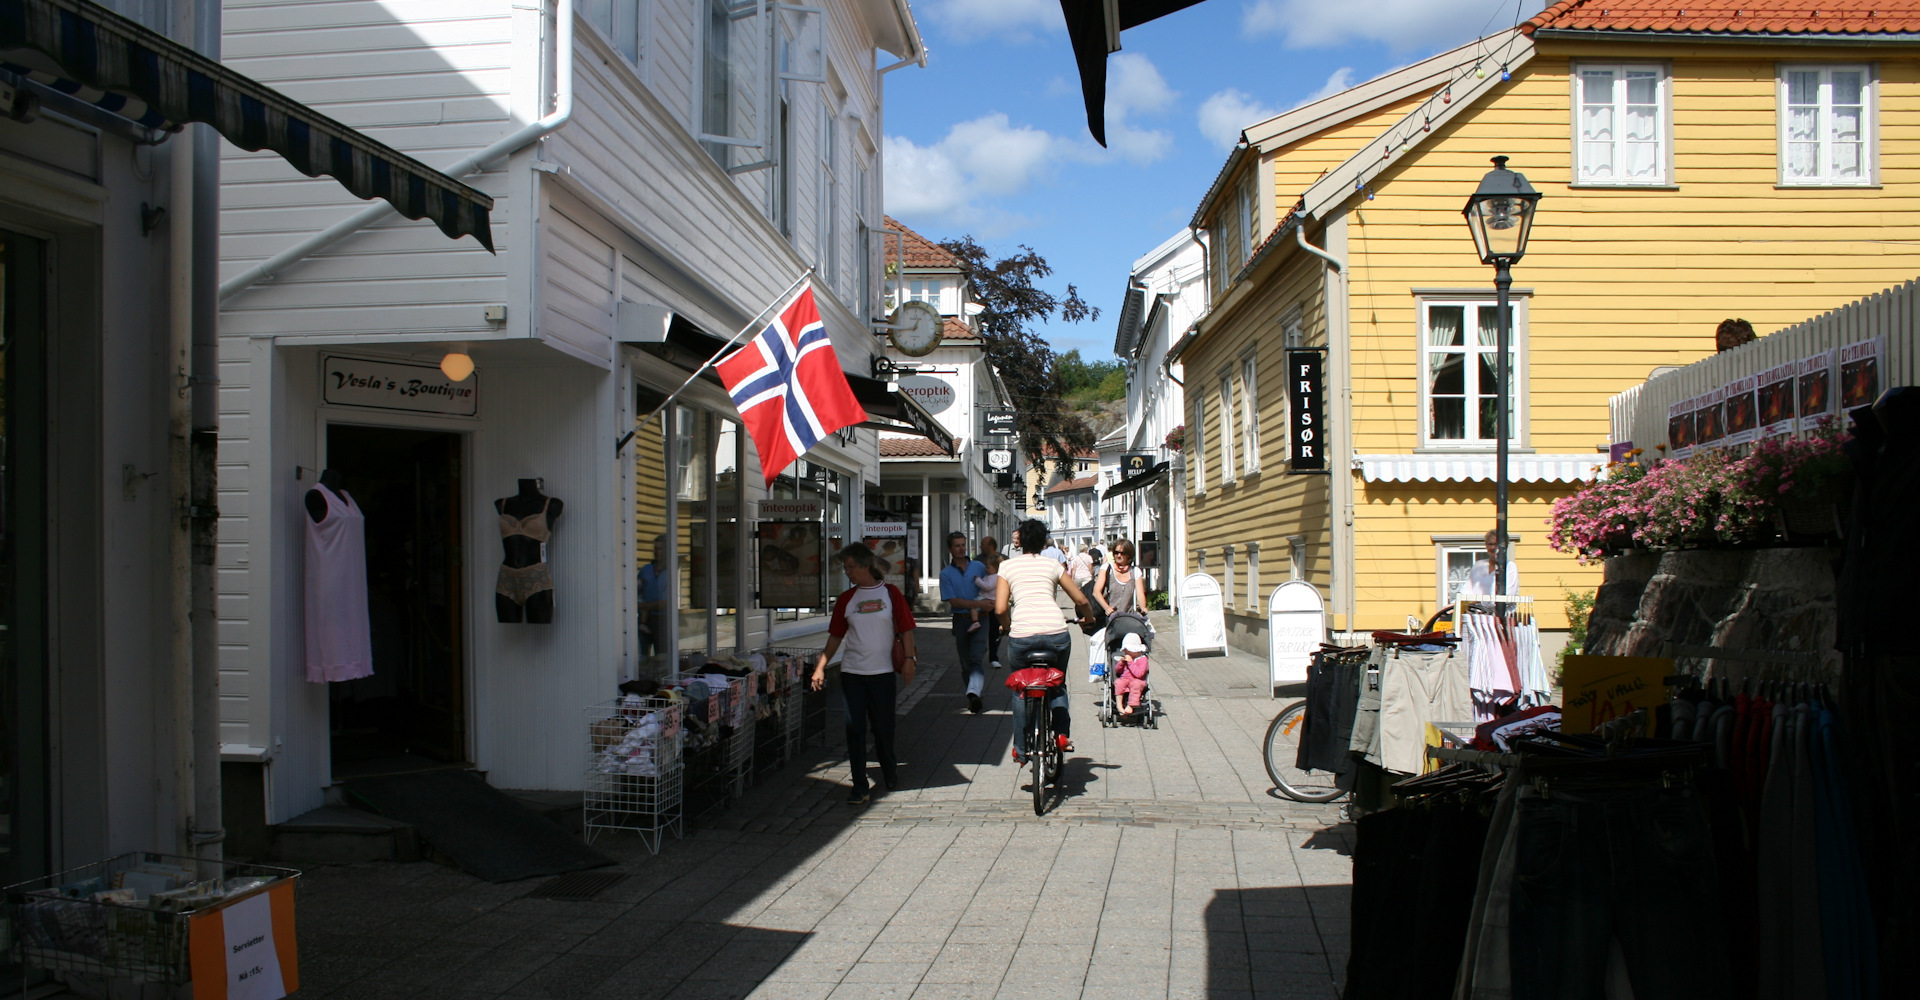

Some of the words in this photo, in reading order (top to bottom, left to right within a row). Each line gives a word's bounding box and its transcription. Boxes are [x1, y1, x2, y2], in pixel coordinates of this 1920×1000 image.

[400, 379, 472, 400] Boutique
[1300, 364, 1313, 458] FRISØR
[1276, 641, 1317, 653] BRUKT
[233, 935, 265, 954] Servietter
